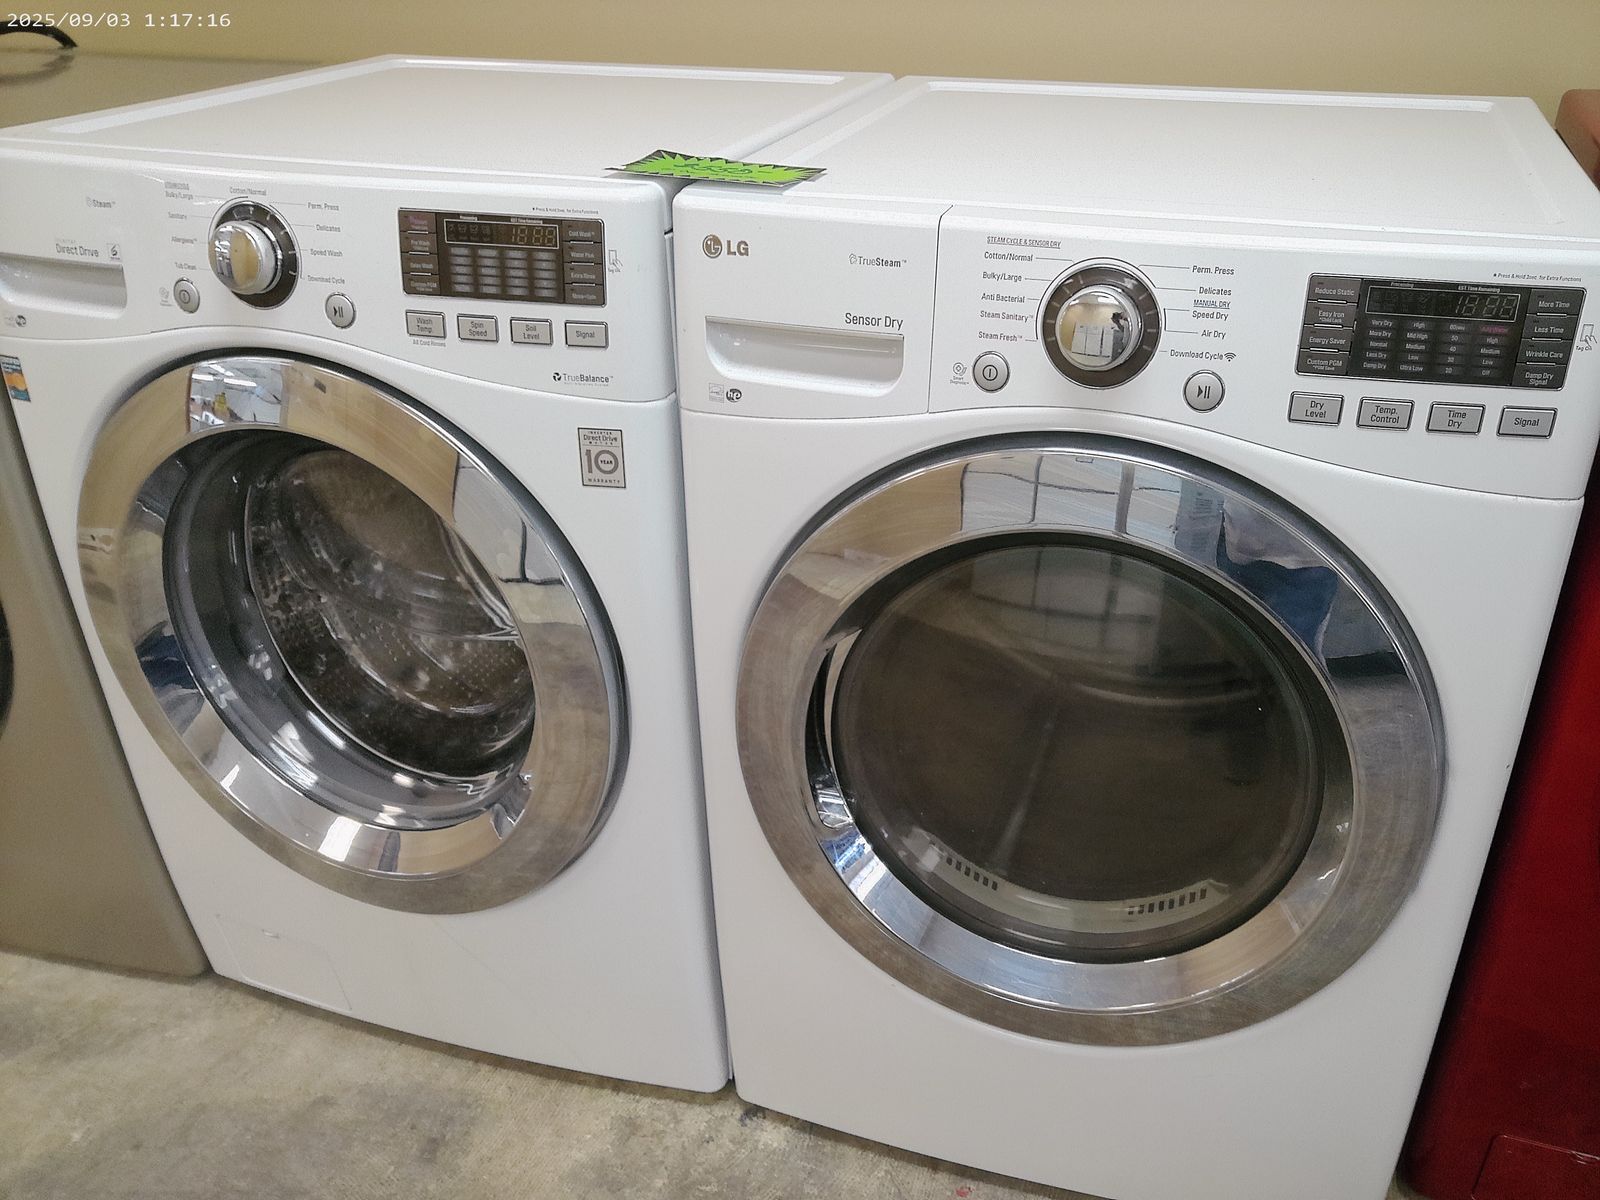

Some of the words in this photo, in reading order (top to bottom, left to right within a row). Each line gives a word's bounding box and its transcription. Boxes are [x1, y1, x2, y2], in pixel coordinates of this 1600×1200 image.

[986, 236, 1006, 244] STEAM
[1028, 240, 1050, 248] SENSOR
[56, 243, 78, 256] Direct
[79, 246, 100, 258] Drive
[726, 240, 749, 256] LG
[984, 252, 1034, 262] Cotton/Normal
[1192, 265, 1212, 274] Perm.
[1214, 266, 1235, 276] Press
[982, 272, 1022, 282] Bulky/Large
[1198, 286, 1232, 296] Delicates
[996, 294, 1026, 303] Bacterial
[1193, 299, 1217, 308] MANUAL
[980, 310, 1000, 319] Steam
[1192, 310, 1215, 320] Speed
[1216, 312, 1229, 321] Dry
[1318, 310, 1332, 318] Easy
[416, 317, 433, 325] Wash
[470, 321, 484, 329] Spin
[844, 312, 882, 327] Sensor
[884, 316, 904, 331] Dry
[576, 330, 596, 340] Signal
[978, 331, 998, 340] Steam
[1201, 330, 1212, 338] Air
[1214, 330, 1226, 340] Dry
[1309, 336, 1329, 344] Energy
[1170, 349, 1204, 359] Download
[1204, 352, 1224, 361] Cycle
[1525, 372, 1542, 380] Damp
[1310, 400, 1324, 410] Dry
[1375, 405, 1398, 415] Temp.
[1305, 410, 1327, 418] Level
[1370, 414, 1400, 424] Control
[1448, 410, 1467, 418] Time
[1448, 420, 1462, 429] Dry
[1514, 417, 1540, 427] Signal
[585, 448, 619, 475] 10
